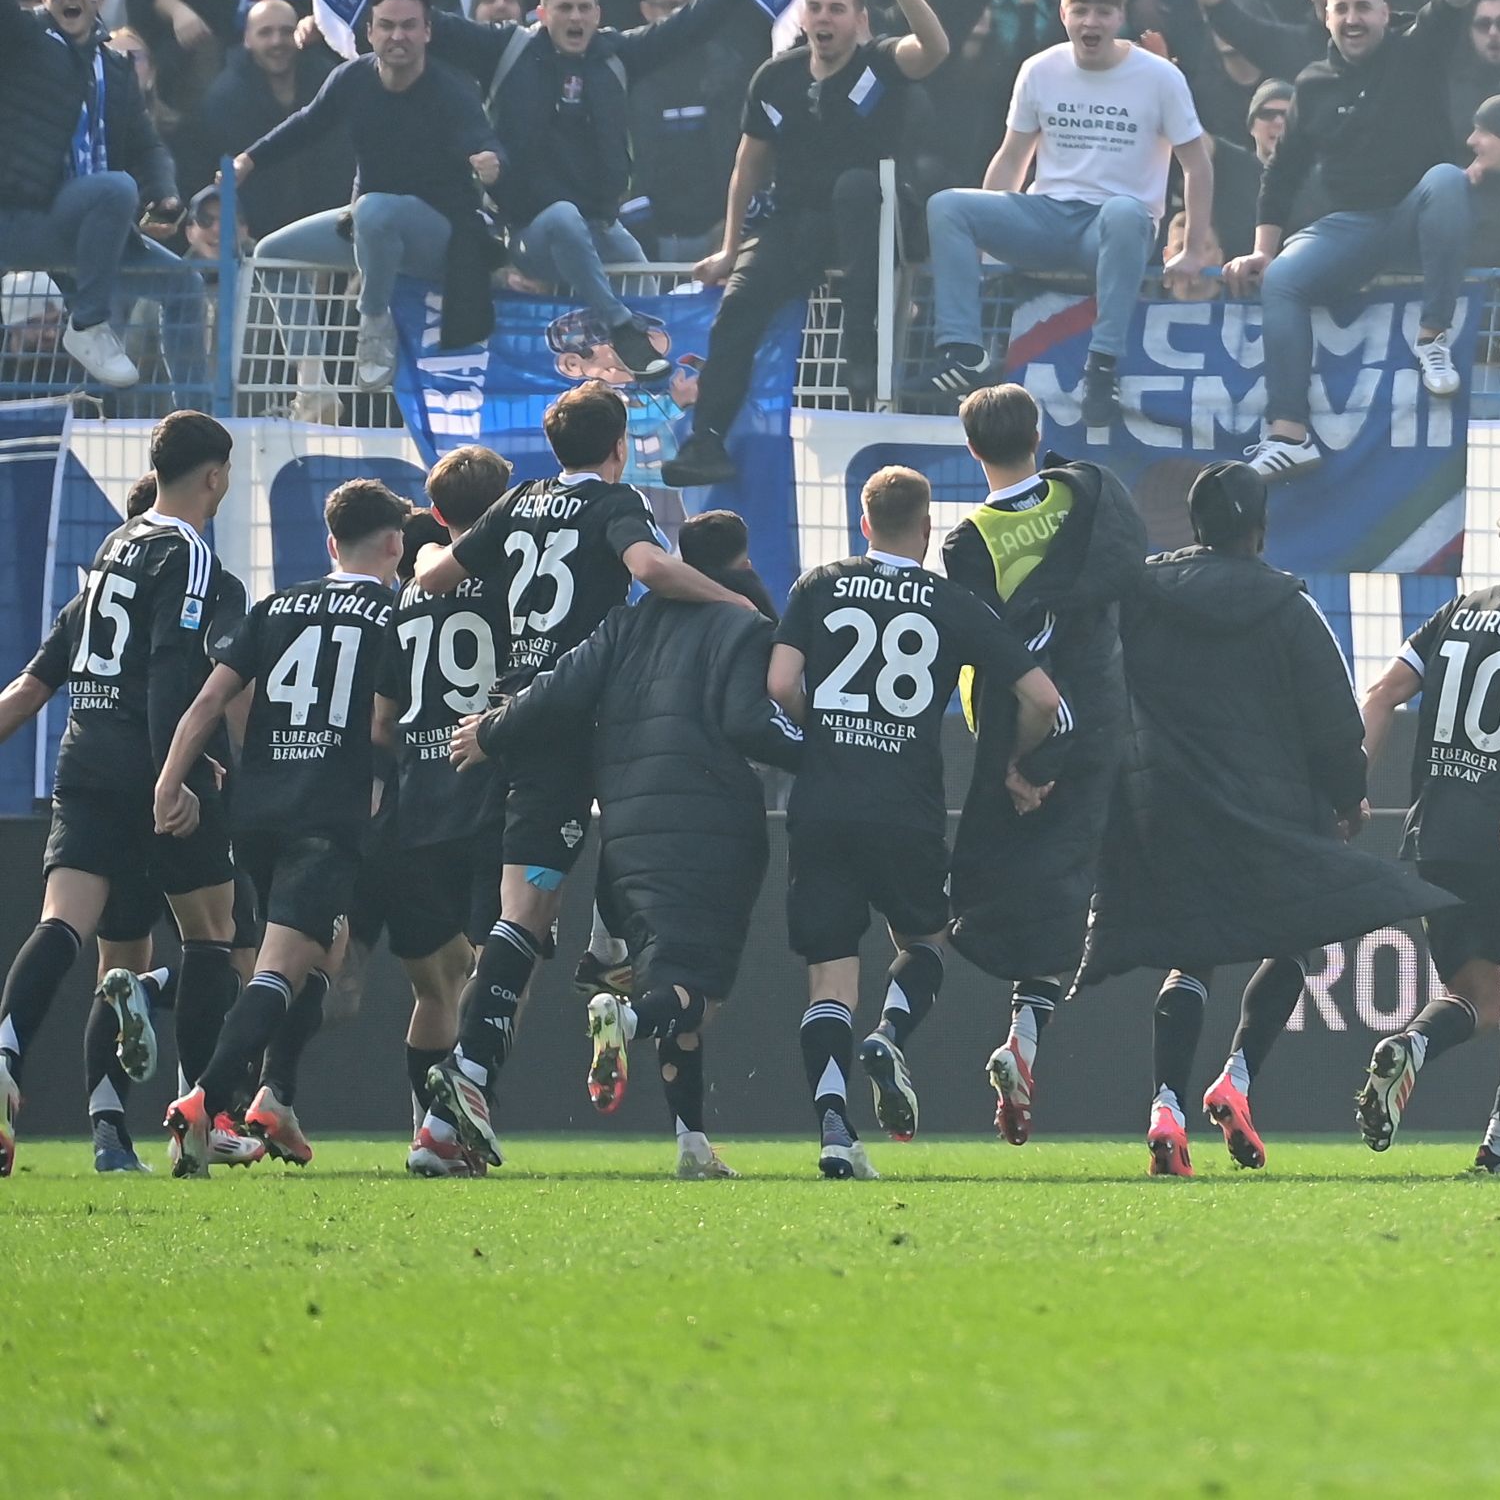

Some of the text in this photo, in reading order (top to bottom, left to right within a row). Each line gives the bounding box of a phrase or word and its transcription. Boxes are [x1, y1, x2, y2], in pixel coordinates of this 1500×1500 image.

[1047, 116, 1138, 133] CONGRESS
[1088, 104, 1130, 118] ICCA
[503, 528, 581, 637] 23
[70, 570, 138, 677] 15
[267, 592, 393, 628] ALEX VALLE
[266, 624, 363, 729] 41
[812, 606, 940, 719] 28
[820, 713, 918, 740] NEUBERGER
[271, 745, 328, 761] BERMAN
[834, 730, 902, 755] BERMAN
